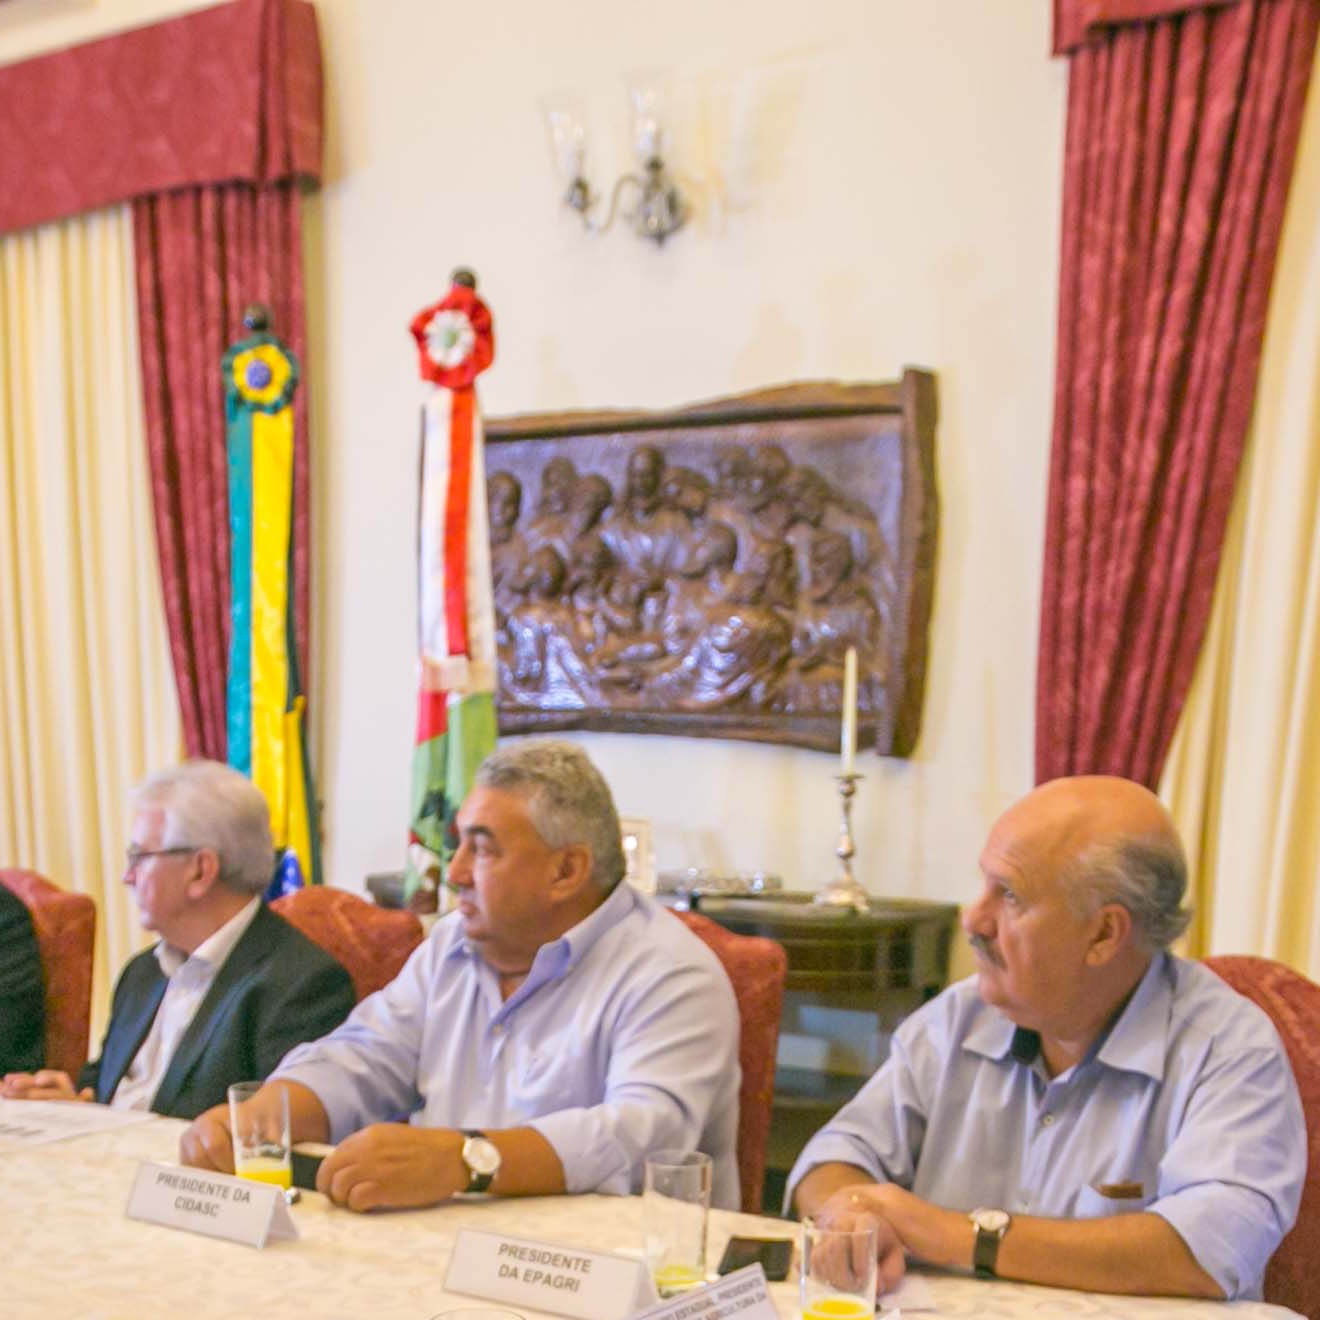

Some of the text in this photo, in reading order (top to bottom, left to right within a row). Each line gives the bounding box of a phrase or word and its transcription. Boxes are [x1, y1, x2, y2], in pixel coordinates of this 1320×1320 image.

[156, 1172, 251, 1203] PRESIDENTE DA
[174, 1196, 220, 1217] CIDASC
[497, 1243, 592, 1274] PRESIDENTE
[498, 1263, 581, 1293] DA EPAGRI
